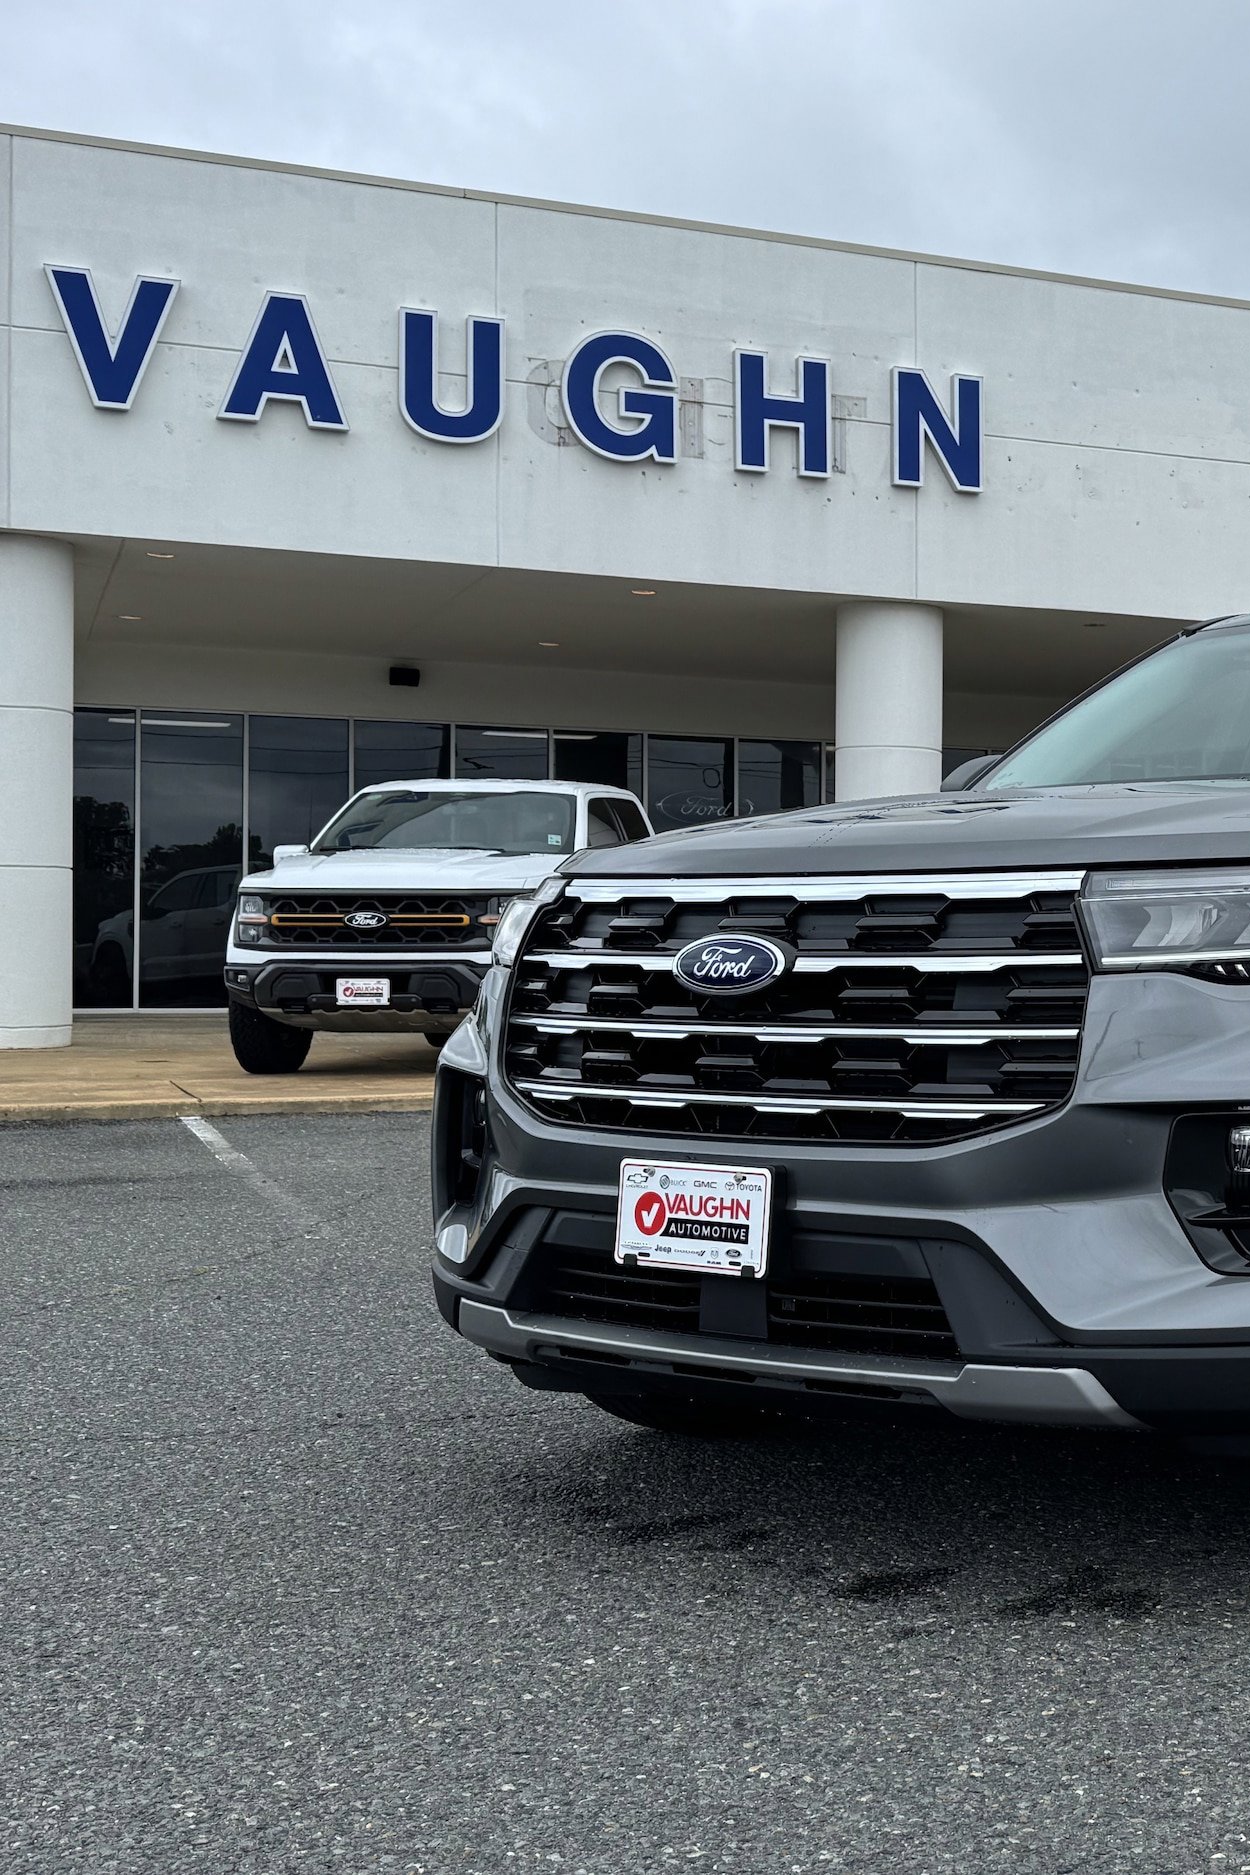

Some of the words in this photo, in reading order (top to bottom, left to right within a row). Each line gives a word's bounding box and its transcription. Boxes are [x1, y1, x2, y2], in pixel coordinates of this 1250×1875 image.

[42, 263, 985, 494] VAUGHN
[680, 795, 732, 817] Ford
[352, 914, 378, 925] Ford
[693, 946, 756, 978] Ford
[693, 1180, 718, 1189] GMC
[736, 1183, 762, 1192] TOYOTA
[665, 1193, 751, 1220] VAUGHN
[669, 1222, 747, 1240] AUTOMOTIVE
[654, 1244, 672, 1254] Jeep
